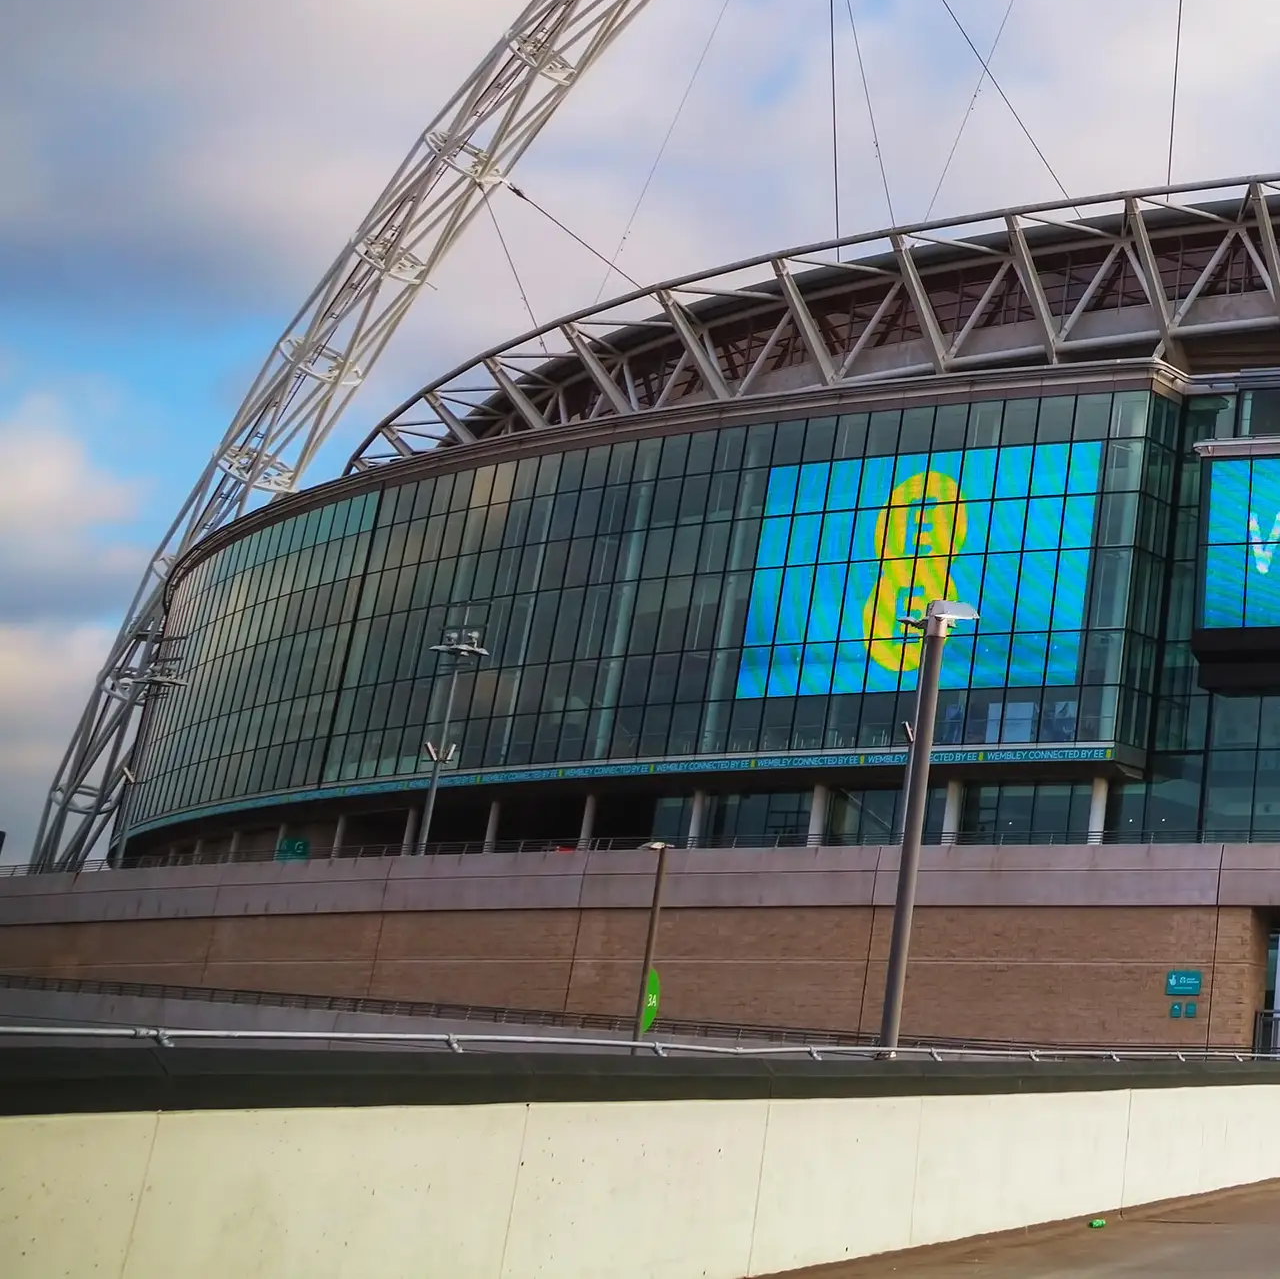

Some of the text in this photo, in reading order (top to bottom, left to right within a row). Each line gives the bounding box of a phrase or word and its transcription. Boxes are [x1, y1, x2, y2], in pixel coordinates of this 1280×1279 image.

[868, 754, 905, 764] WEMBLEY
[955, 753, 966, 761] BY
[967, 752, 977, 760] EE
[987, 749, 1104, 761] WEMBLEY CONNECTED BY EE
[757, 756, 858, 767] WEMBLEY CONNECTED BY EE
[647, 994, 657, 1007] 3A
